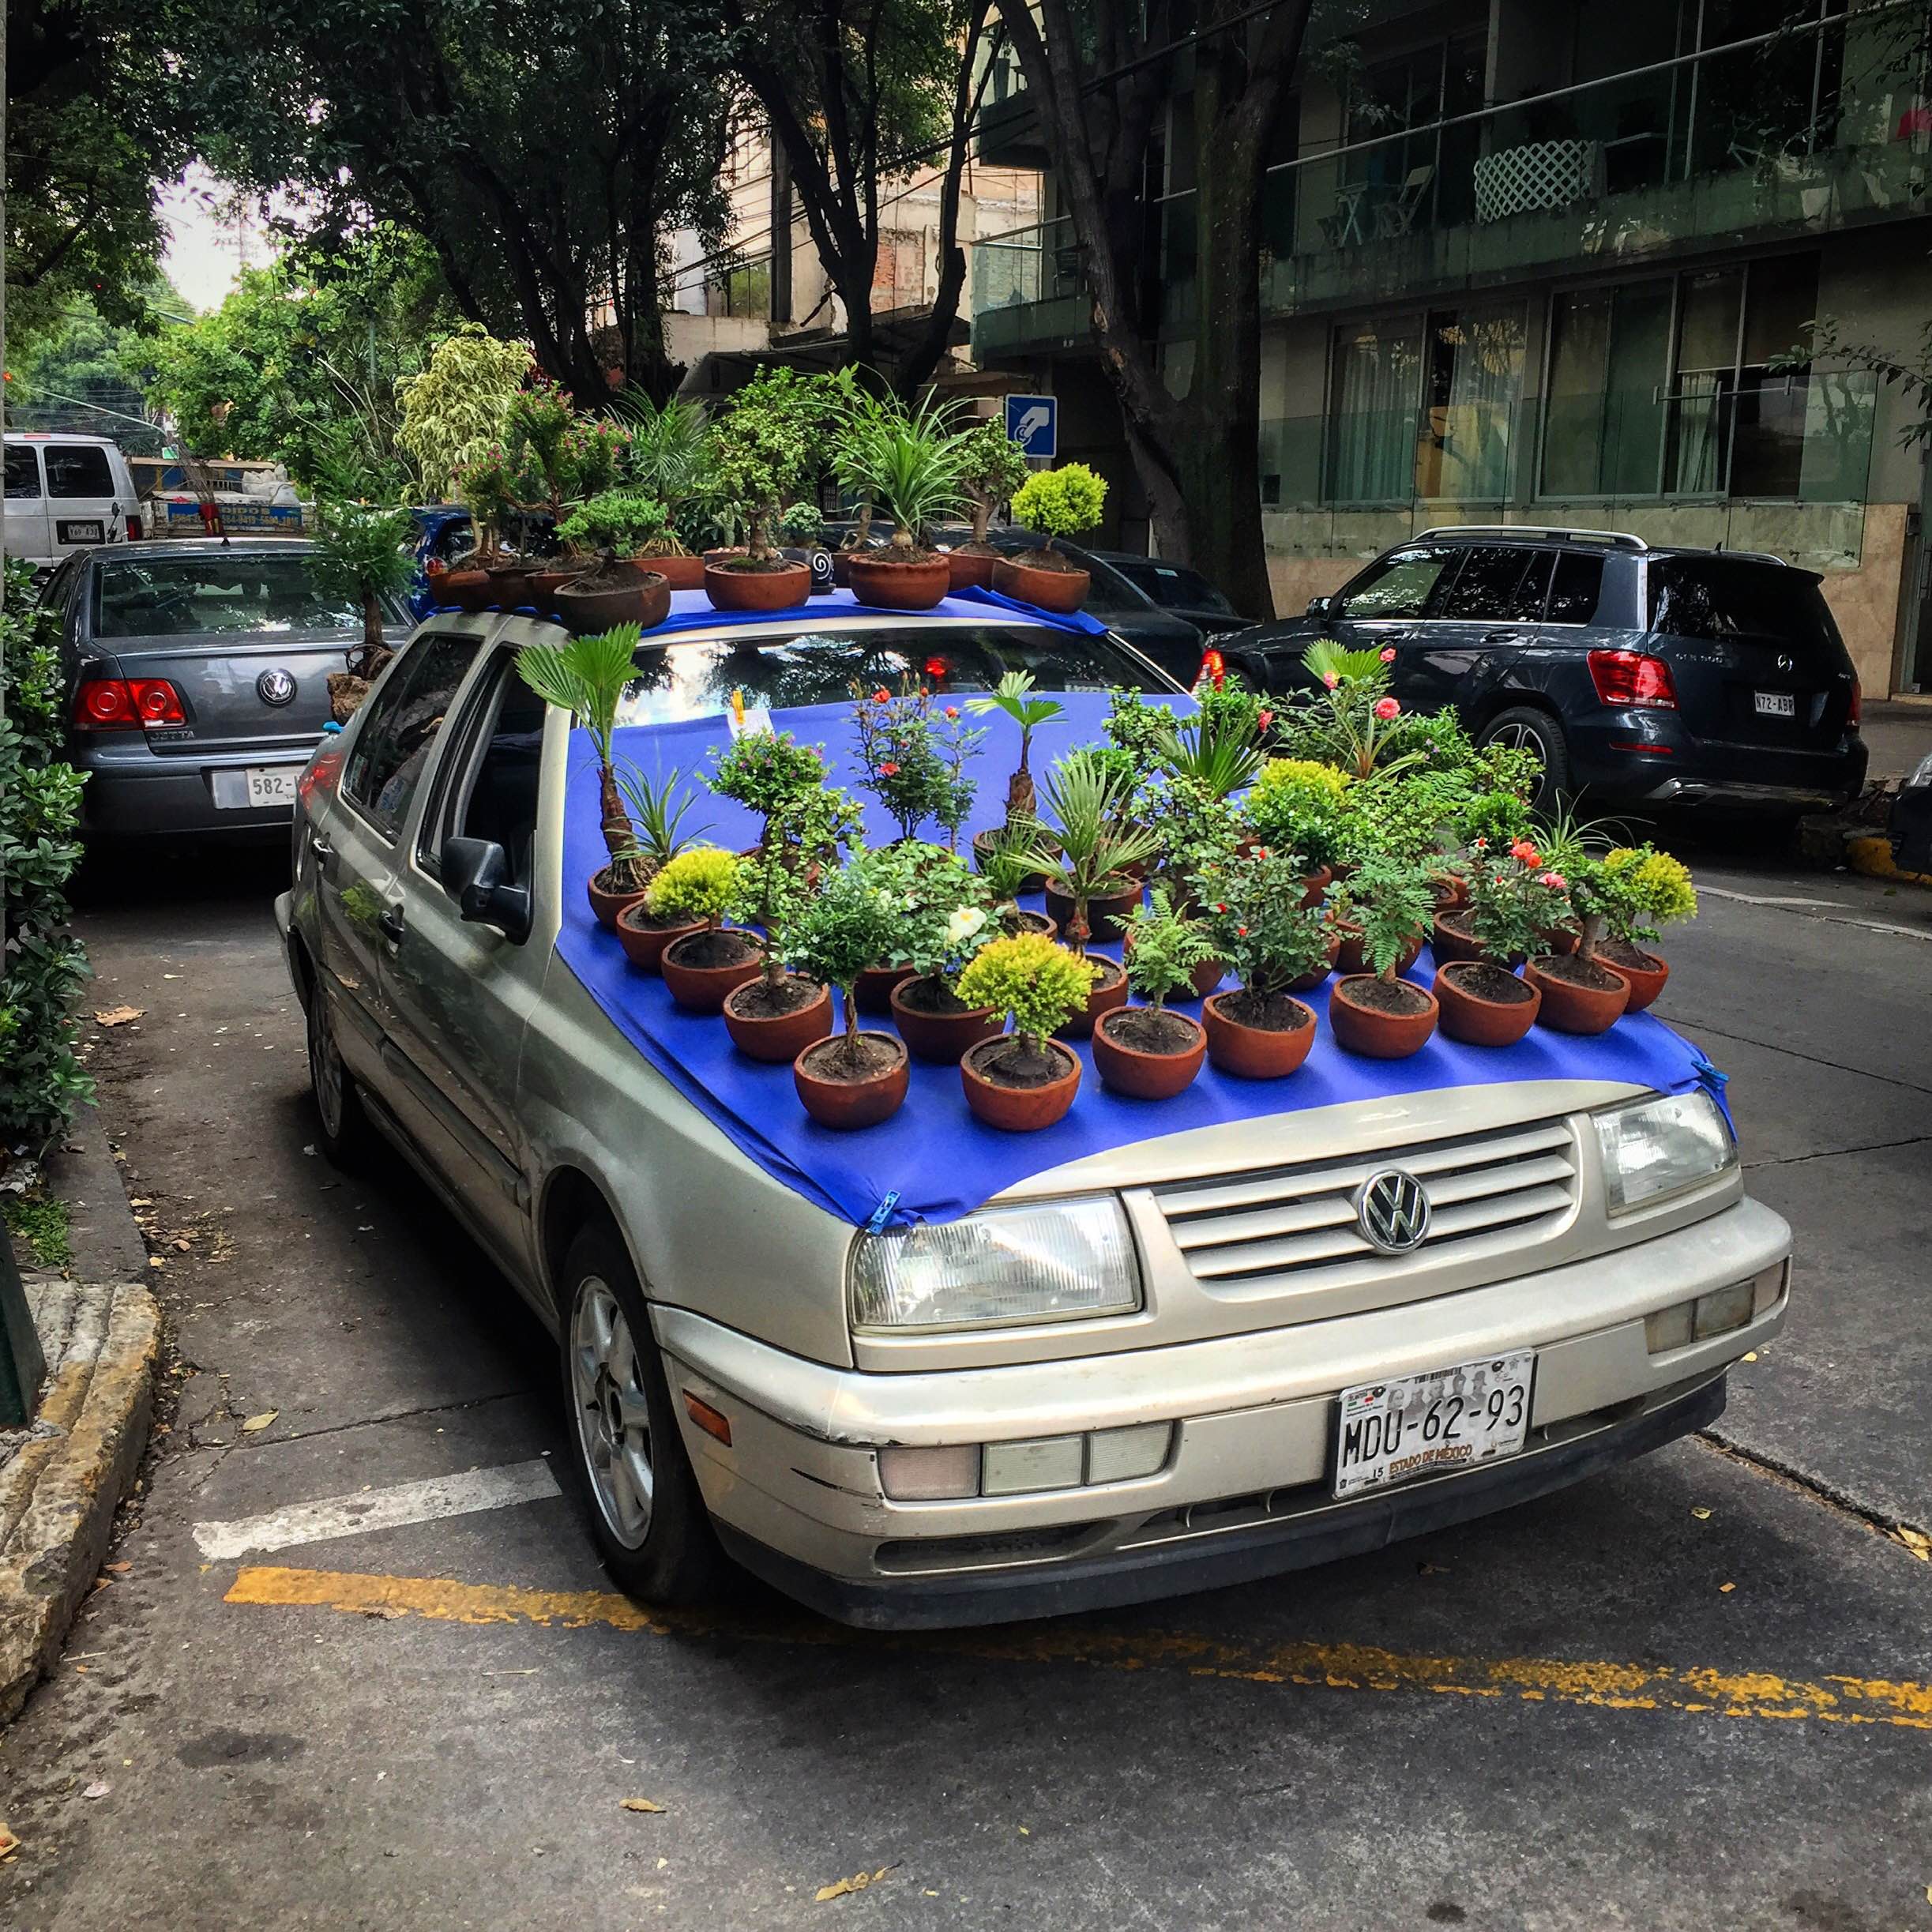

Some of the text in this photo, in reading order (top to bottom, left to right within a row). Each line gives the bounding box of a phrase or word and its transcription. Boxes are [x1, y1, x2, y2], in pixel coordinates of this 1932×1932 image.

[1362, 1171, 1427, 1249] VW
[1343, 1385, 1524, 1468] MDU-62-93
[1373, 1467, 1384, 1478] 15
[1389, 1453, 1422, 1475] ESTADO
[1422, 1449, 1434, 1462] DE
